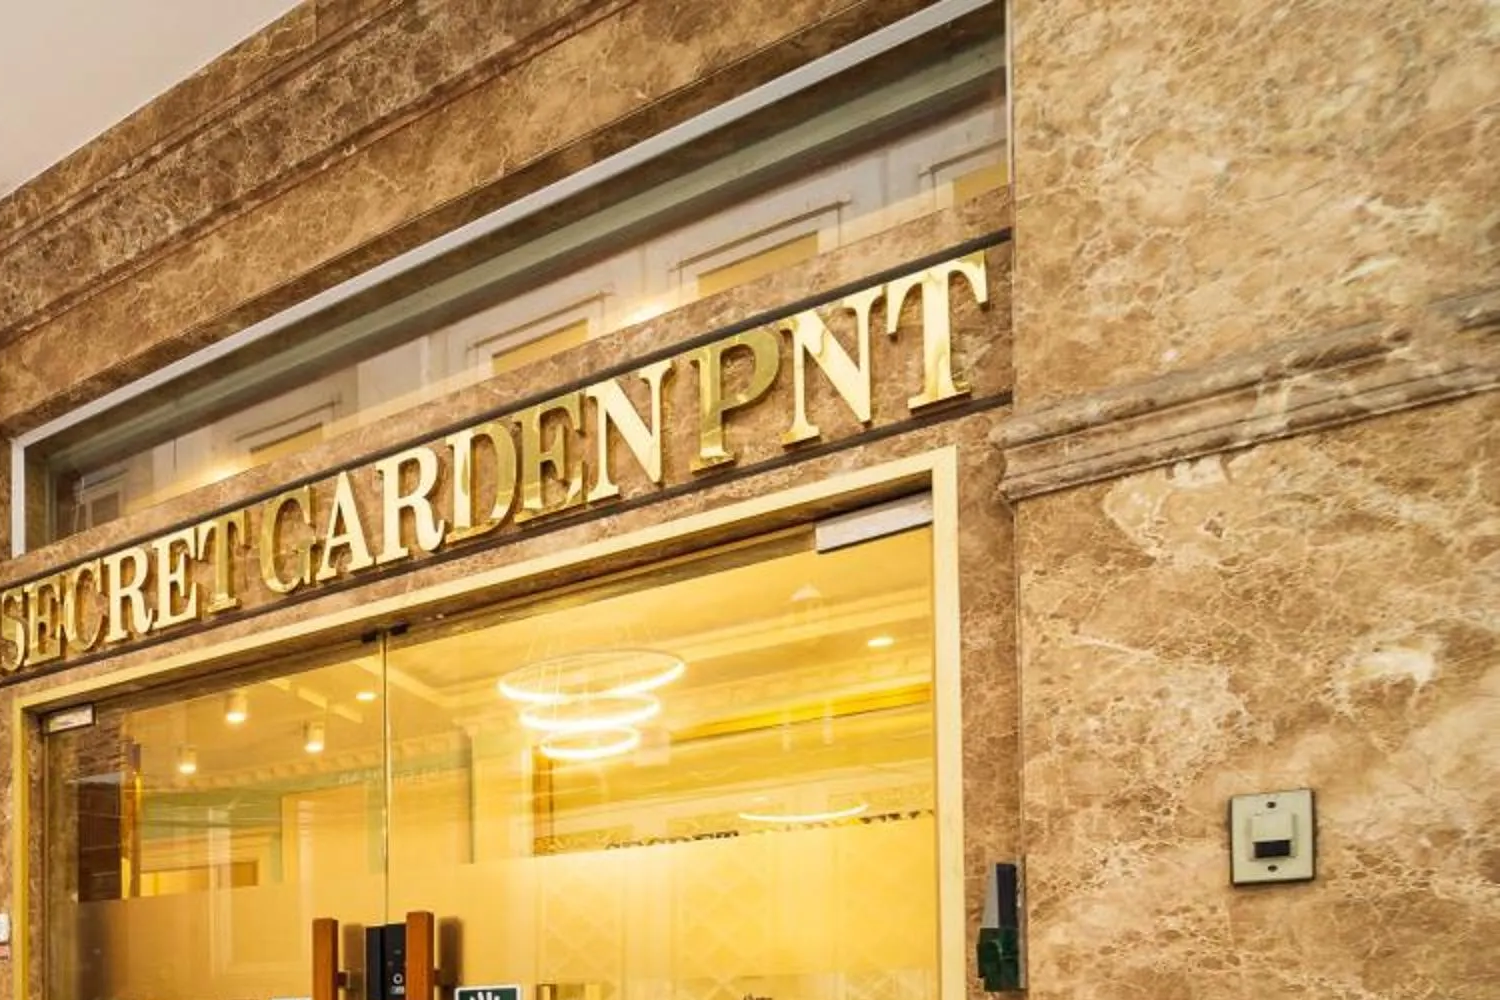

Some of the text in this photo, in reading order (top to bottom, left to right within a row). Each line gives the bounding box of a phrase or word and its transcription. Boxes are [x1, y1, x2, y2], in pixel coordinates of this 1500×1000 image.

[0, 249, 990, 673] SECRET GARDEN PNT
